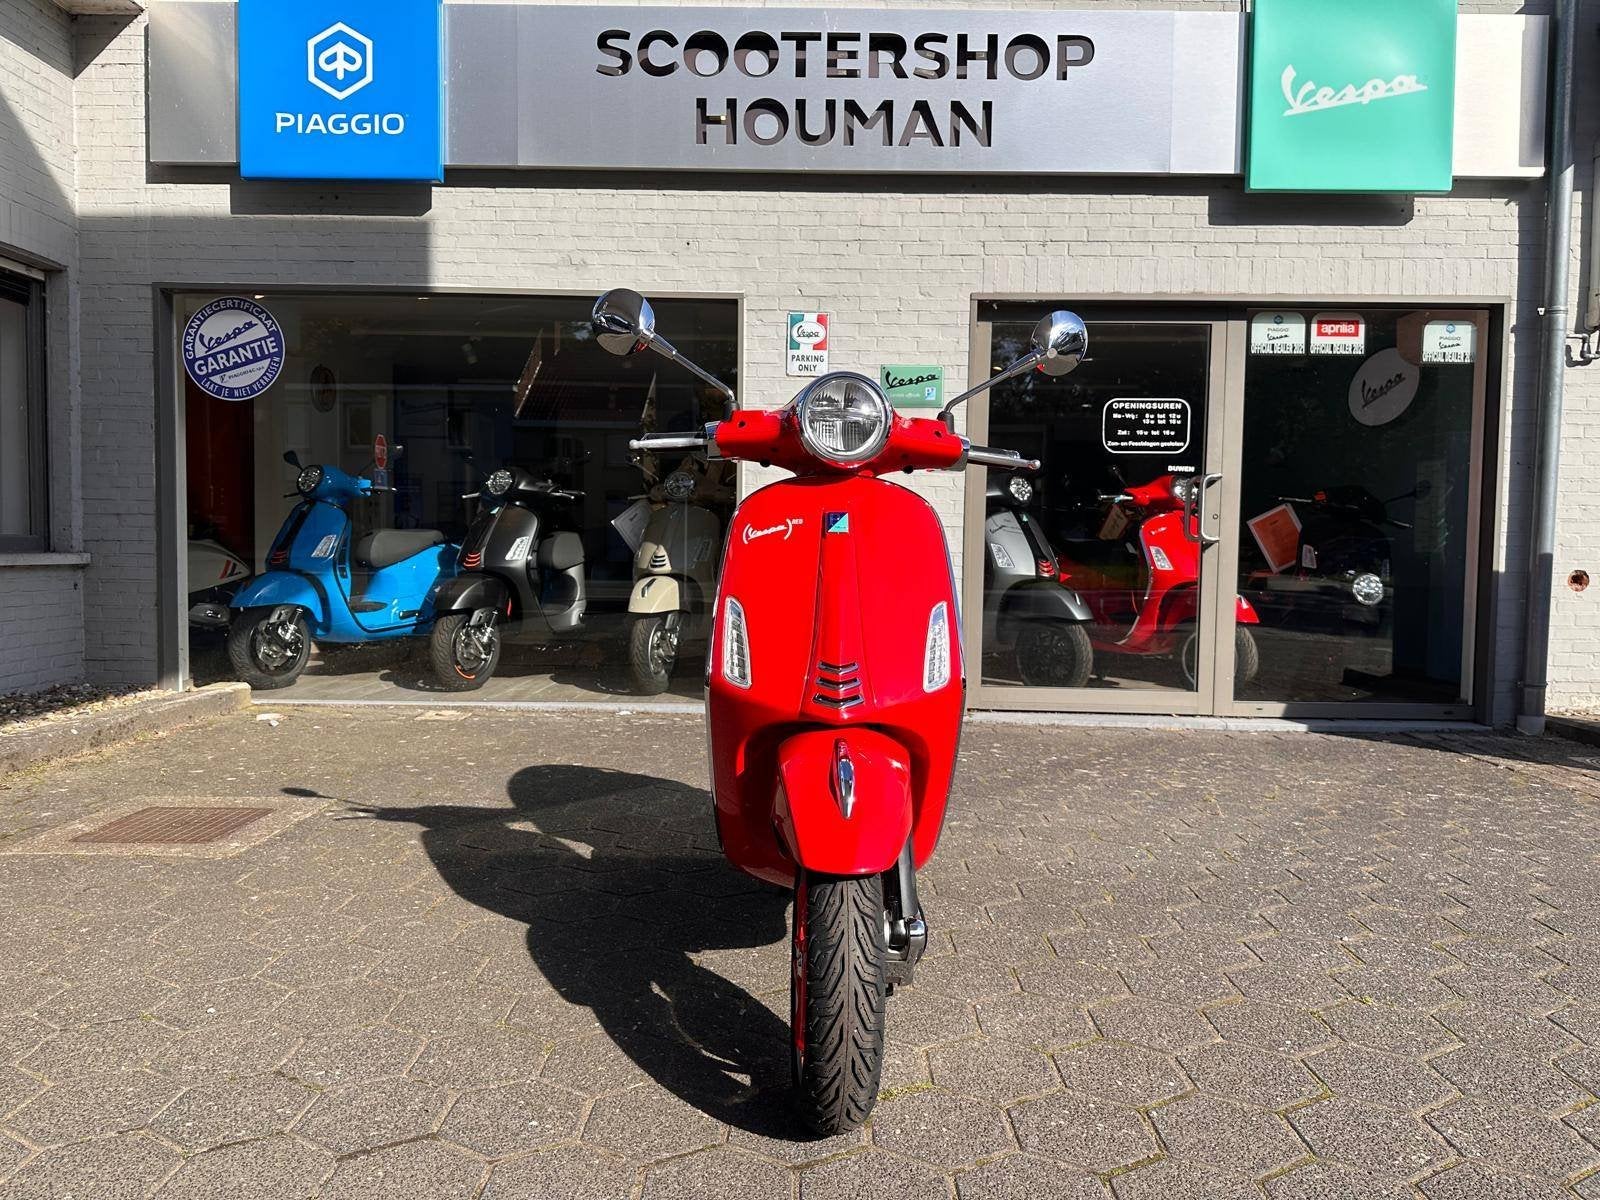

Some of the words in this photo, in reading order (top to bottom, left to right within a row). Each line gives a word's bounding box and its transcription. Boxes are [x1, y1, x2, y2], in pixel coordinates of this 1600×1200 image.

[595, 29, 1095, 81] SCOOTERSHOP
[1281, 64, 1428, 117] Vespa
[275, 112, 405, 135] PIAGGIO
[694, 97, 993, 148] HOUMAN
[185, 299, 278, 360] GARANTIECERTIFICAAT
[198, 320, 259, 354] Vespa
[796, 325, 821, 338] Vespa
[1321, 321, 1355, 335] aprilia
[194, 336, 279, 376] GARANTIE
[791, 354, 825, 363] PARKING
[798, 363, 818, 372] ONLY
[201, 377, 218, 393] LAAT
[220, 388, 230, 398] JE
[234, 387, 251, 398] NIET
[252, 356, 281, 391] VERRASSEN
[885, 370, 940, 390] Vespa
[1361, 372, 1406, 410] Vespa
[1112, 402, 1182, 410] OPENINGSUREN
[1167, 465, 1195, 473] DUWEN
